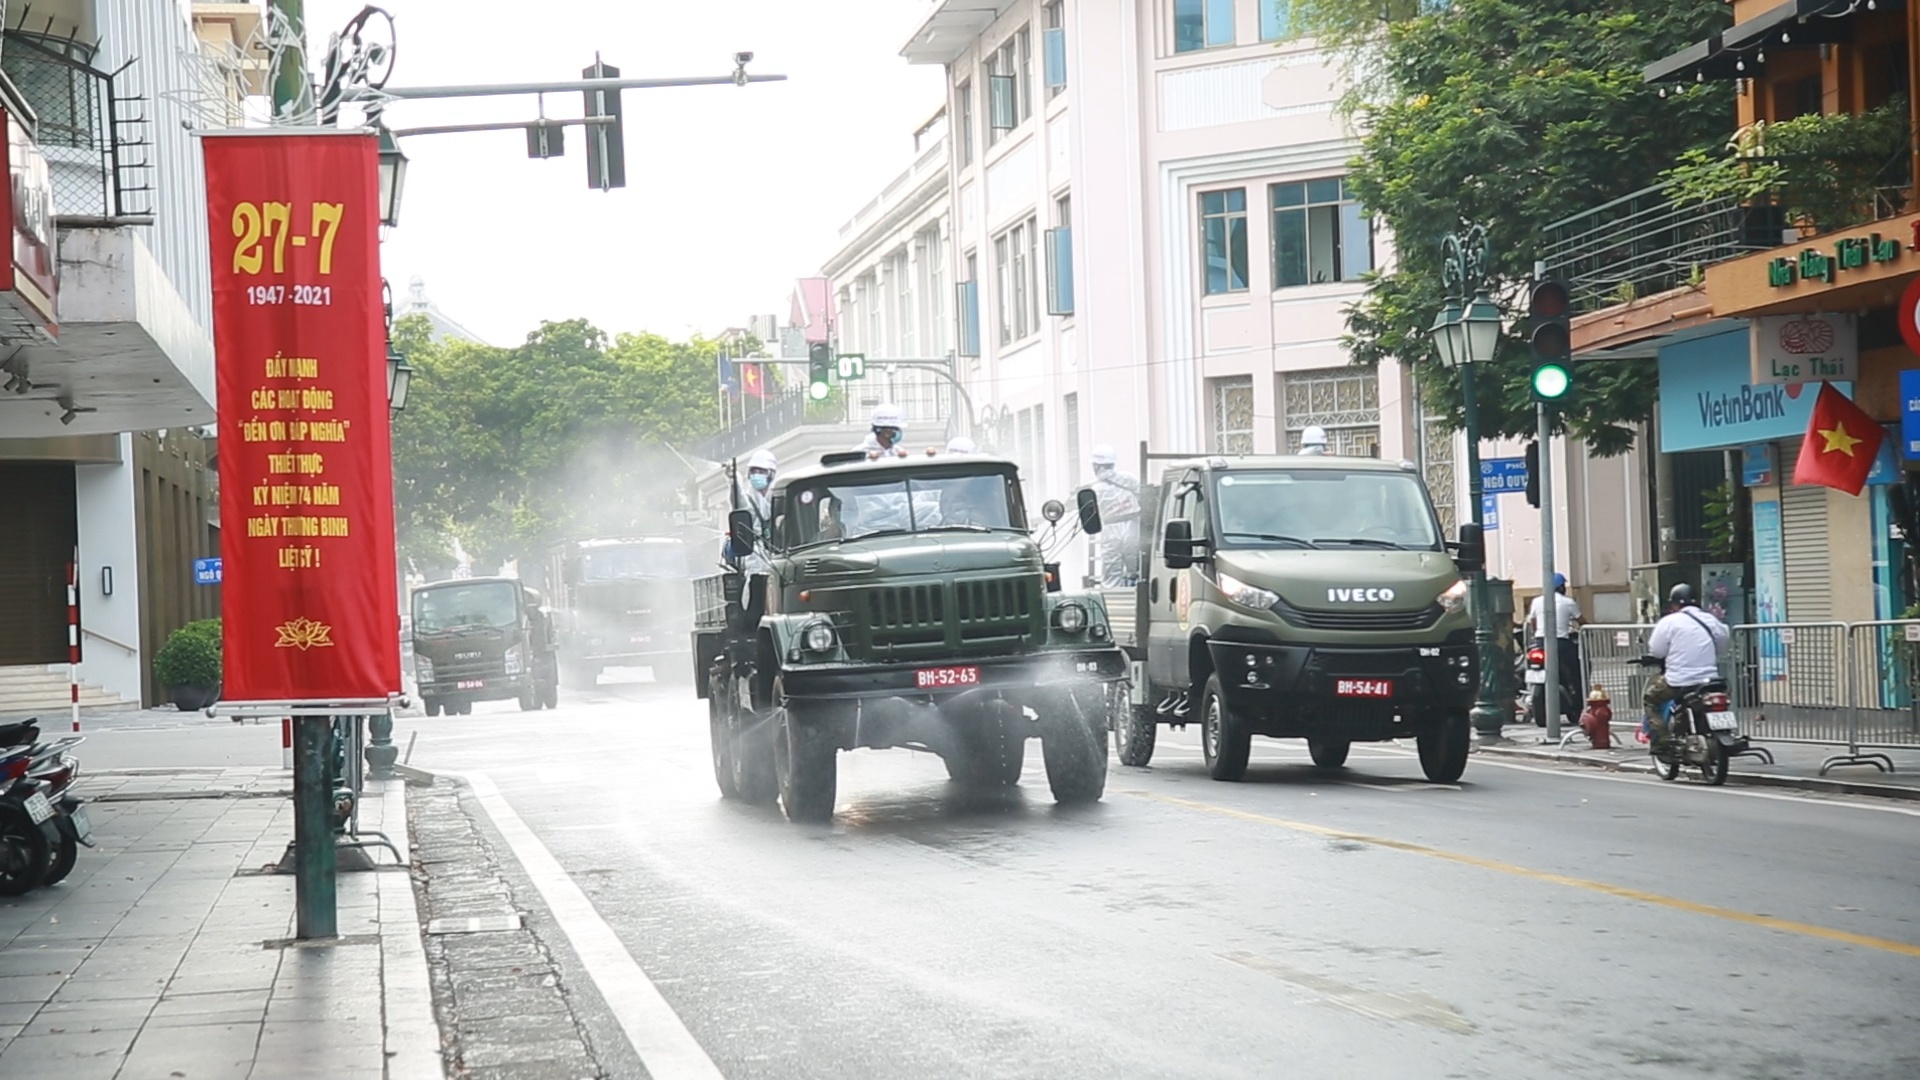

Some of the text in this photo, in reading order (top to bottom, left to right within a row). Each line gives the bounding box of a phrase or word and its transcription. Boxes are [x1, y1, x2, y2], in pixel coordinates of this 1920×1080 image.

[232, 201, 344, 275] 27-7
[1799, 248, 1835, 283] Hàng
[1834, 238, 1868, 270] Thái
[1870, 233, 1900, 262] Lan
[247, 285, 285, 305] 1947
[293, 285, 331, 305] 2021
[1772, 357, 1844, 380] Lạc Thái
[251, 385, 276, 410] CÁC
[302, 385, 334, 414] ĐỘNG
[1697, 384, 1785, 428] VietinBank
[267, 447, 324, 478] THIẾT THỰC
[1483, 472, 1505, 489] NGÔ
[298, 486, 312, 505] 74
[313, 482, 340, 506] NĂM
[248, 513, 279, 537] NGÀY
[320, 516, 349, 537] BINH
[1328, 588, 1395, 602] IVECO
[918, 668, 977, 686] BH-52-63
[1337, 680, 1388, 695] BH-54-41
